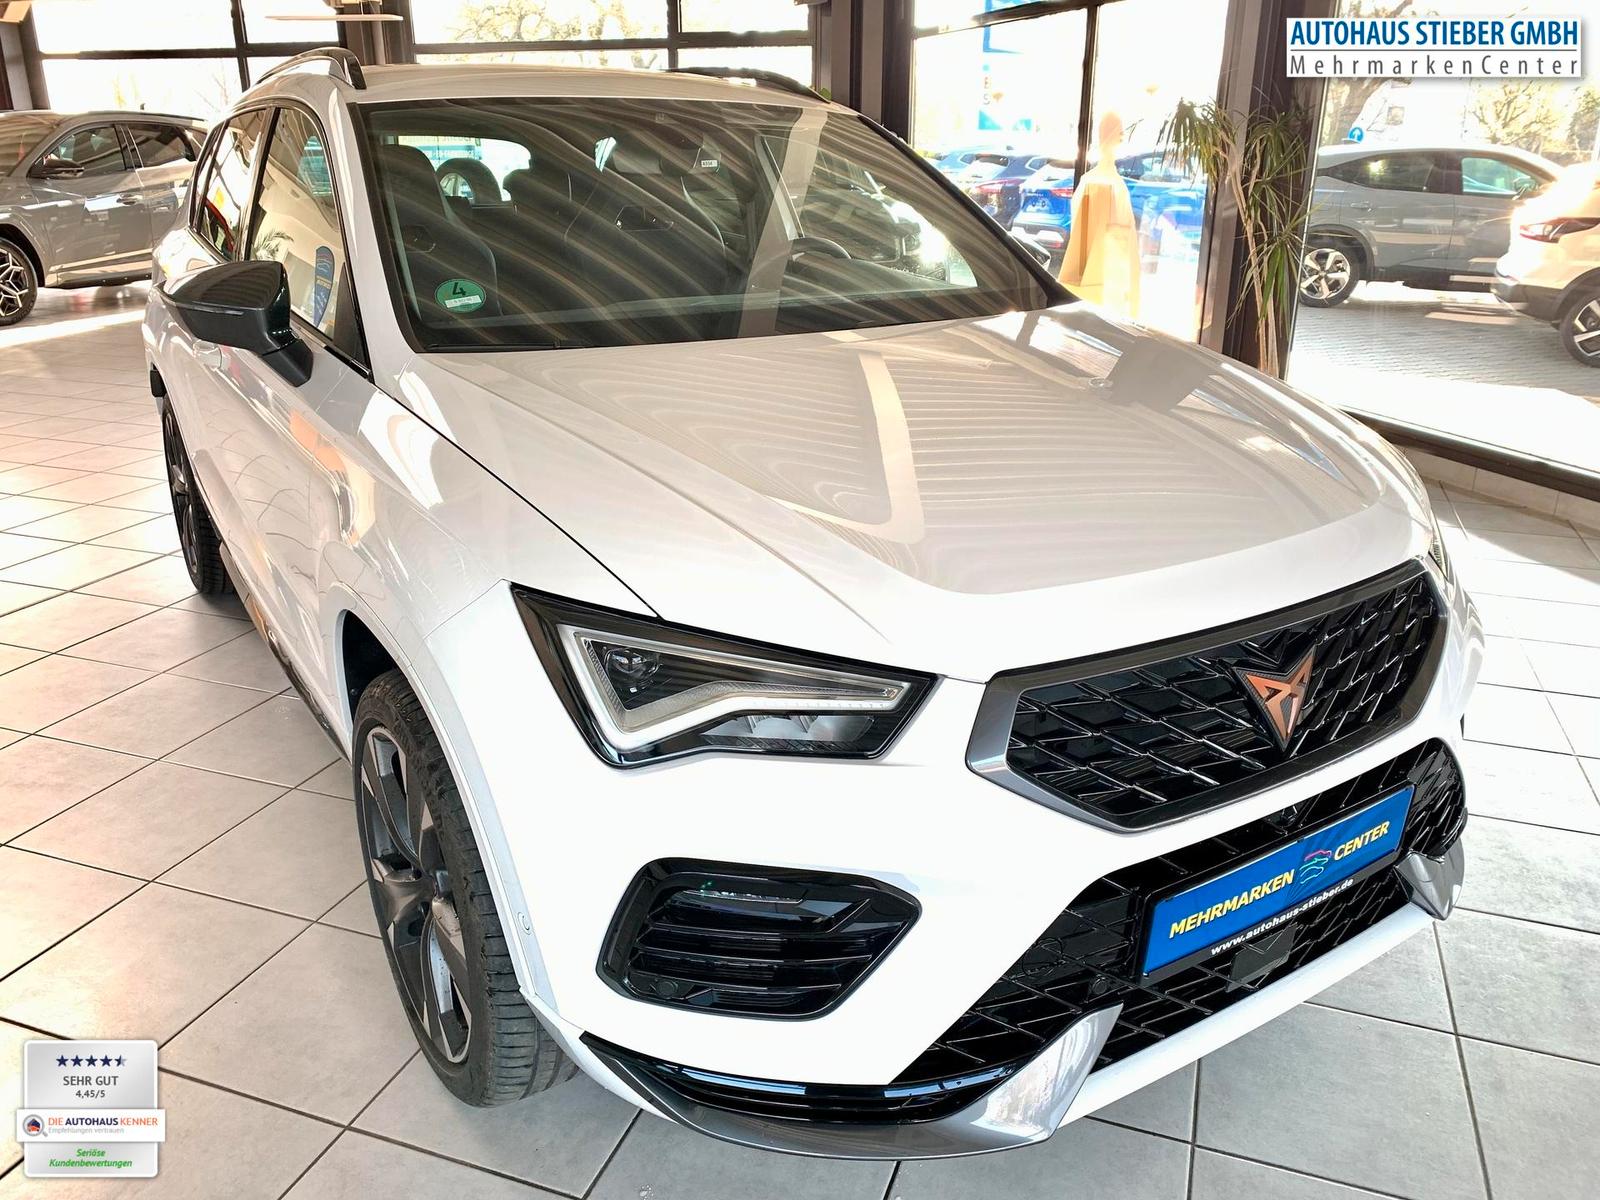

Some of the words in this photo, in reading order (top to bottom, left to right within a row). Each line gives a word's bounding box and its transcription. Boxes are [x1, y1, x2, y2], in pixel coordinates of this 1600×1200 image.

[452, 281, 467, 296] 4
[1169, 869, 1296, 939] MEHRMARKEN
[1333, 820, 1391, 861] CENTER
[1210, 877, 1354, 956] www.autohaus-stieber.de
